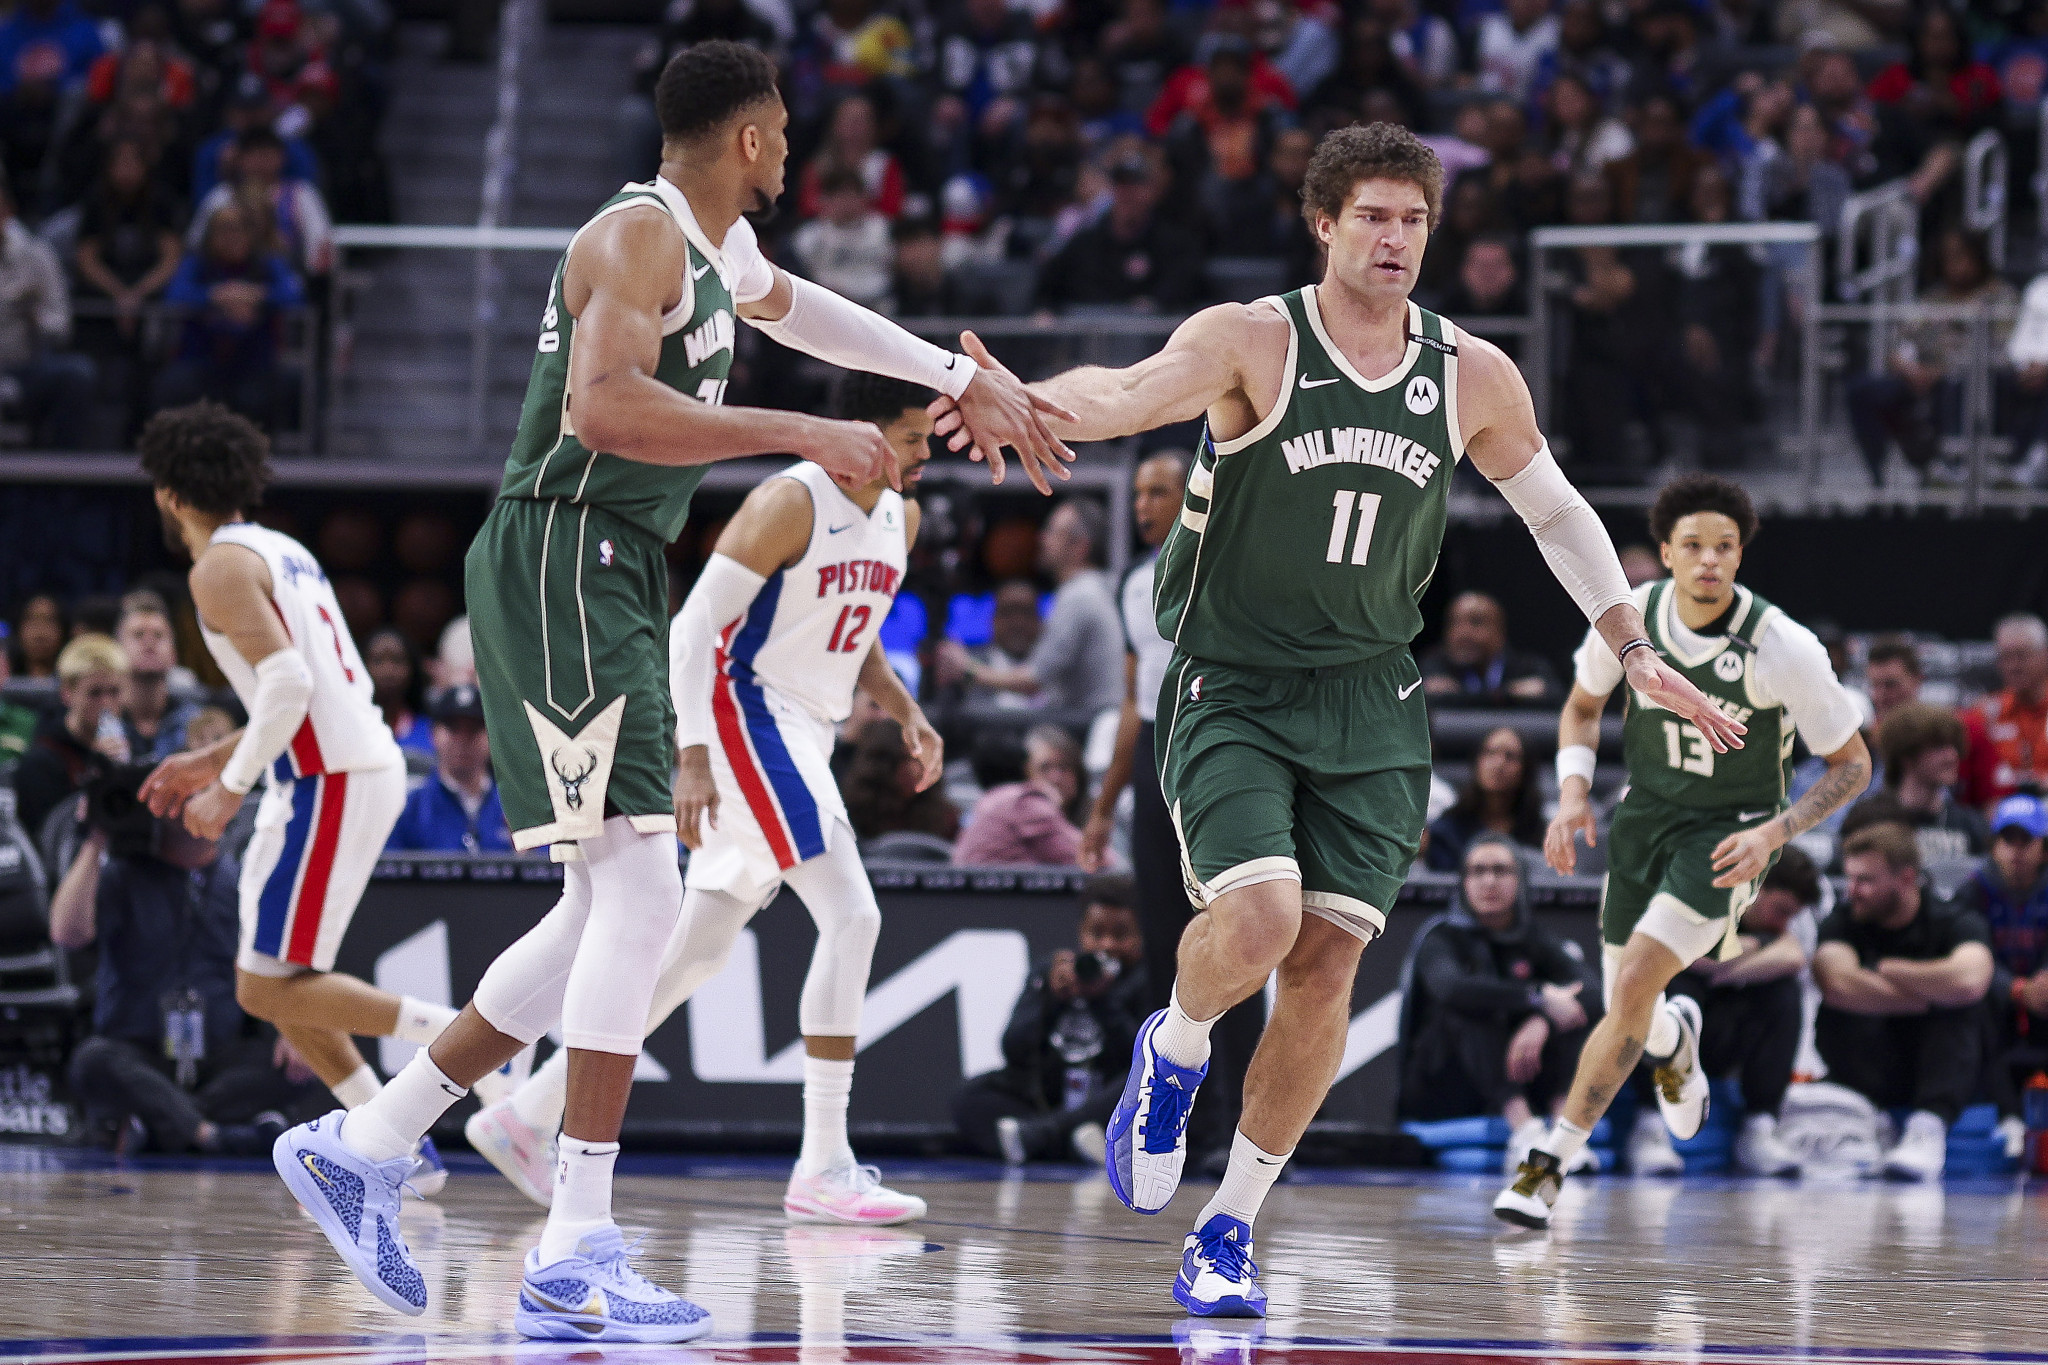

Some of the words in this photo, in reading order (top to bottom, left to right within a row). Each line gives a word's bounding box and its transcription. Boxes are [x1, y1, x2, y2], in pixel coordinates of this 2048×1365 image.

[1414, 336, 1453, 353] BRIDGEMAN
[1280, 427, 1442, 489] MILWAUKEE
[1326, 489, 1382, 566] 11
[818, 559, 900, 599] PISTON
[826, 604, 872, 653] 12
[1662, 719, 1715, 778] 13
